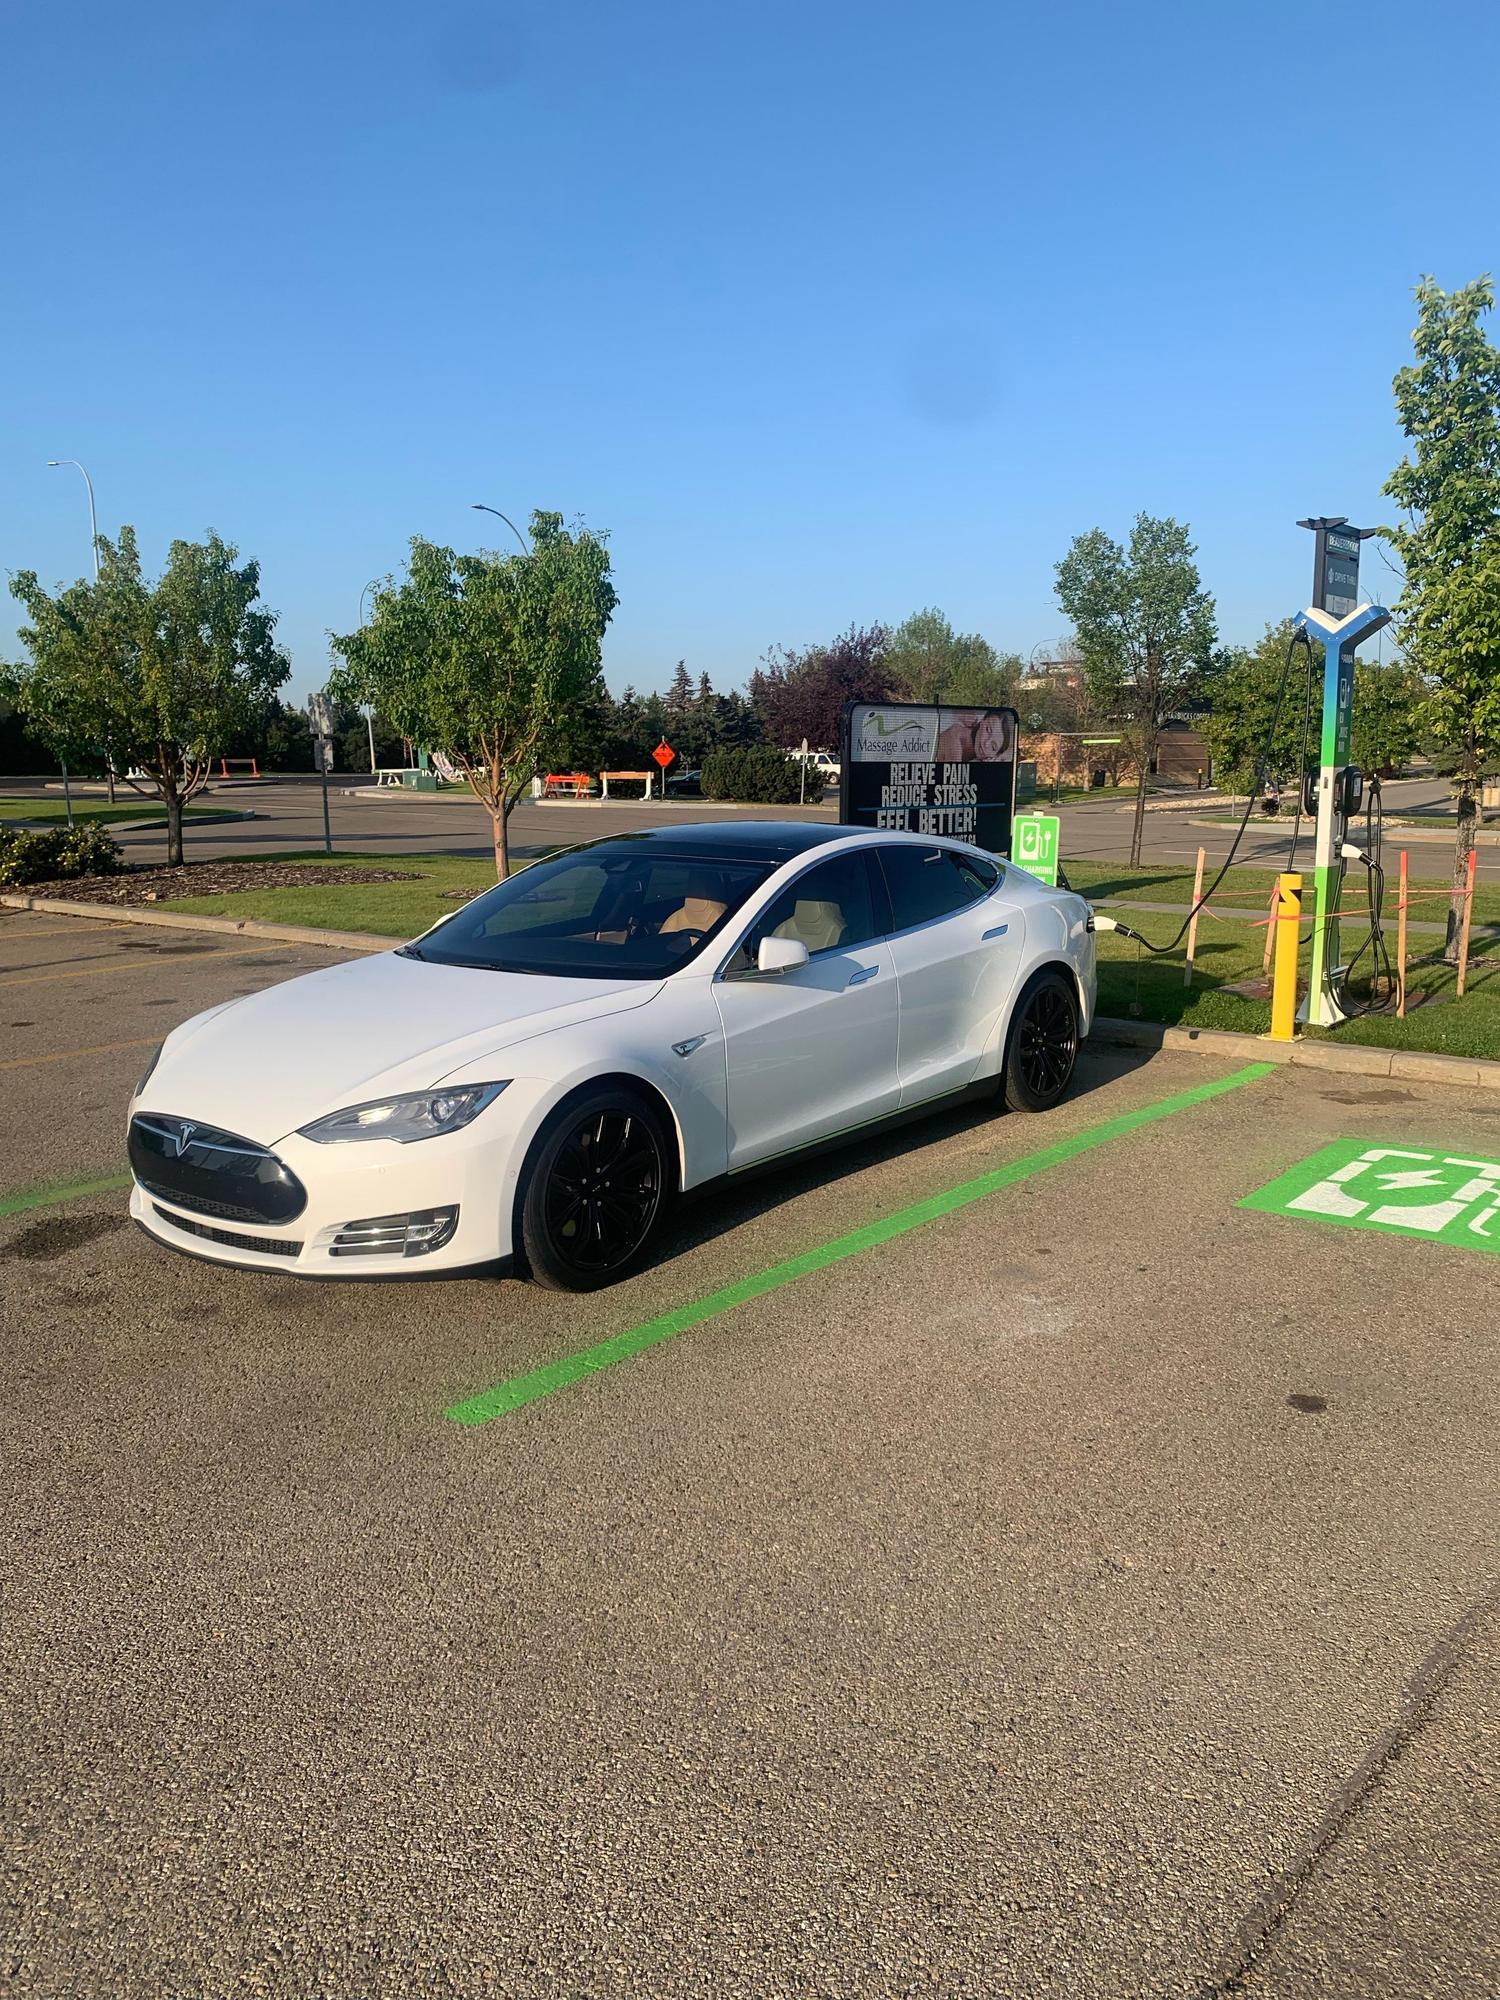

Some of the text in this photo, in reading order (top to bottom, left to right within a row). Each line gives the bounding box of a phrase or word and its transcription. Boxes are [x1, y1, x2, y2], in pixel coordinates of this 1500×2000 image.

[857, 738, 930, 755] Massage Addict
[890, 763, 970, 785] RELIEVE PAIN
[881, 784, 978, 807] REDUCE STRESS
[919, 807, 977, 834] BETTER!
